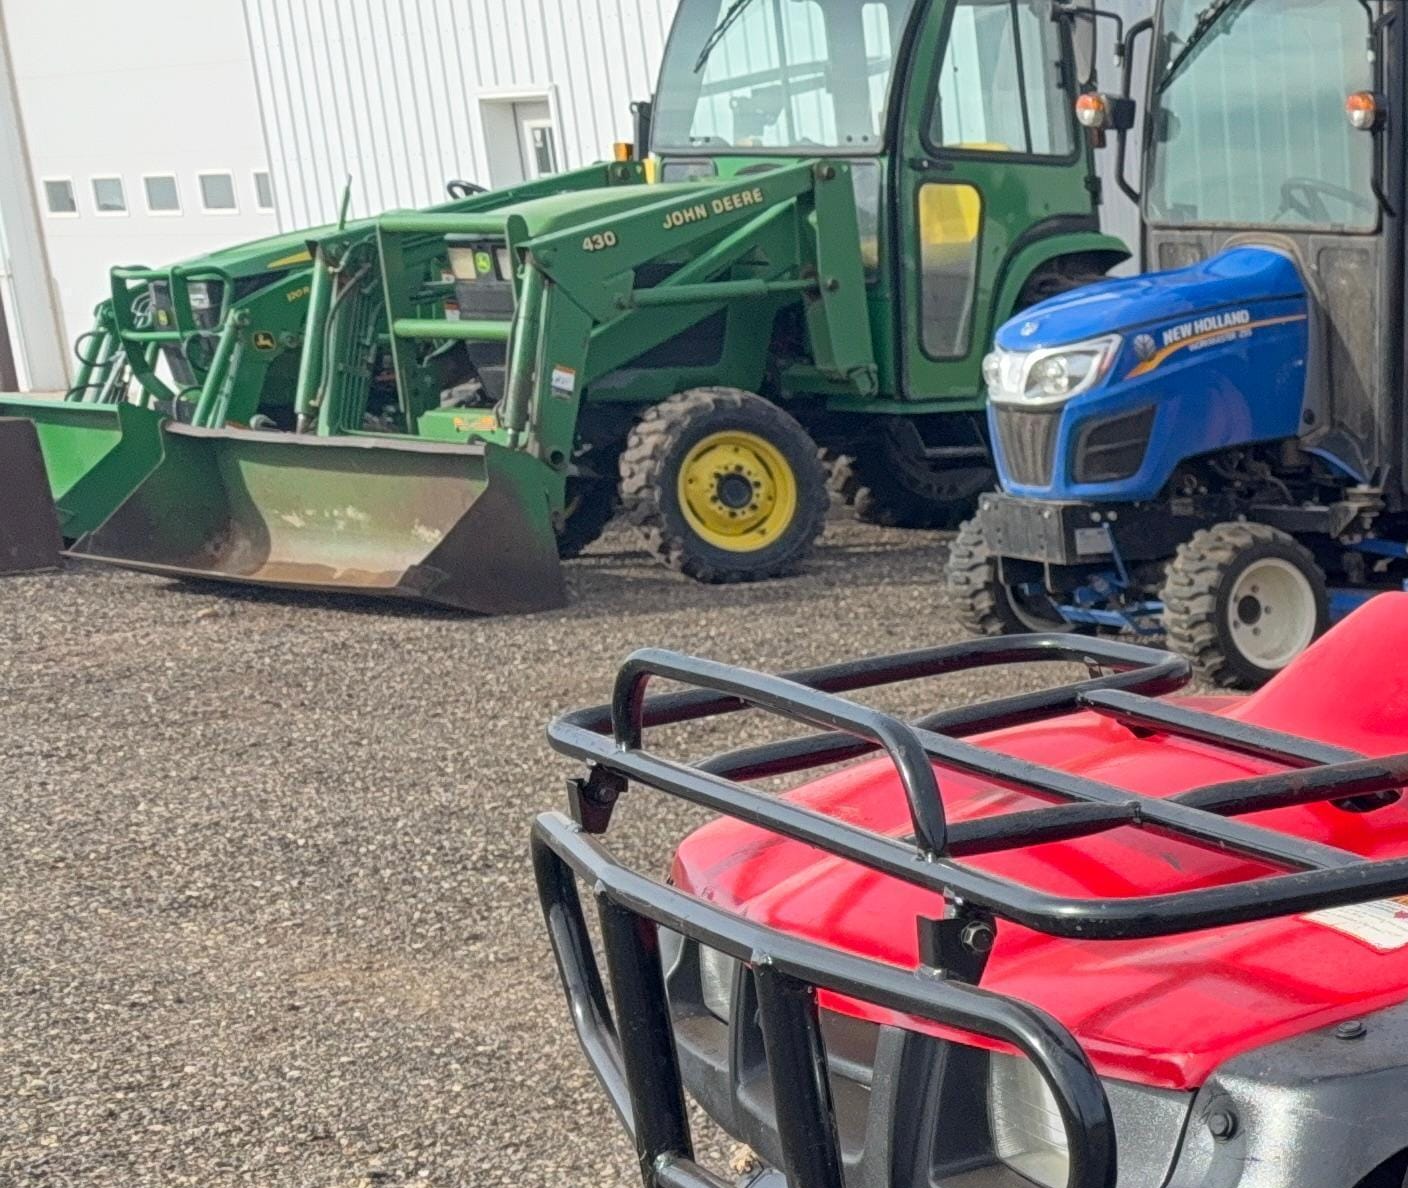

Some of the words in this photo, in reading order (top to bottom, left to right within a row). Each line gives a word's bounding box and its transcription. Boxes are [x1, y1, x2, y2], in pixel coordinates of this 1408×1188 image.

[663, 206, 708, 229] JOHN
[712, 188, 763, 214] DEERE
[582, 231, 617, 251] 430
[1163, 322, 1193, 346] NEW
[1194, 310, 1250, 334] HOLLAND
